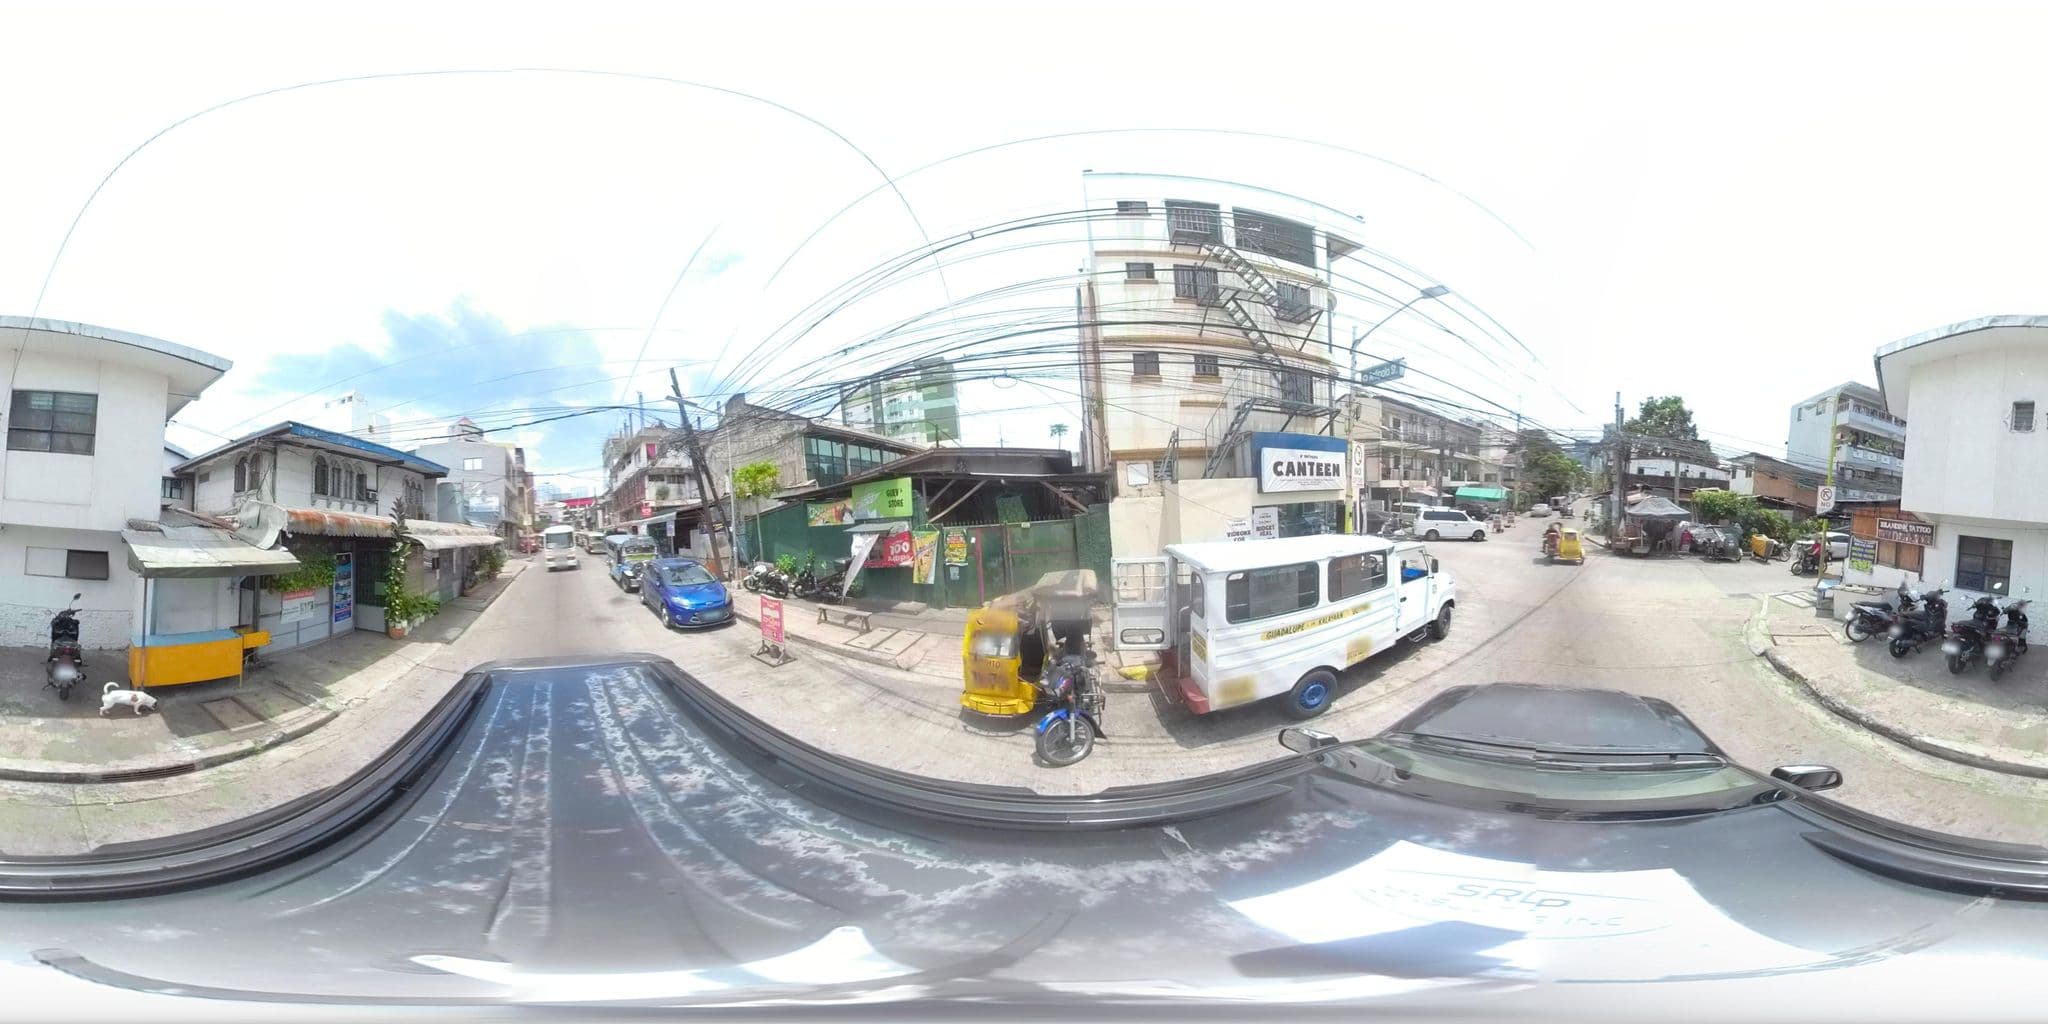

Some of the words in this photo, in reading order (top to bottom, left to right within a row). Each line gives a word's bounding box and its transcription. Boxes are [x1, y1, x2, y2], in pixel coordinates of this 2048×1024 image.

[1273, 461, 1340, 477] CANTEEN
[888, 499, 904, 508] STORE
[1908, 524, 1932, 534] TATTOO
[1266, 623, 1305, 640] GUADALUPE
[1318, 611, 1343, 625] KALAYAAN
